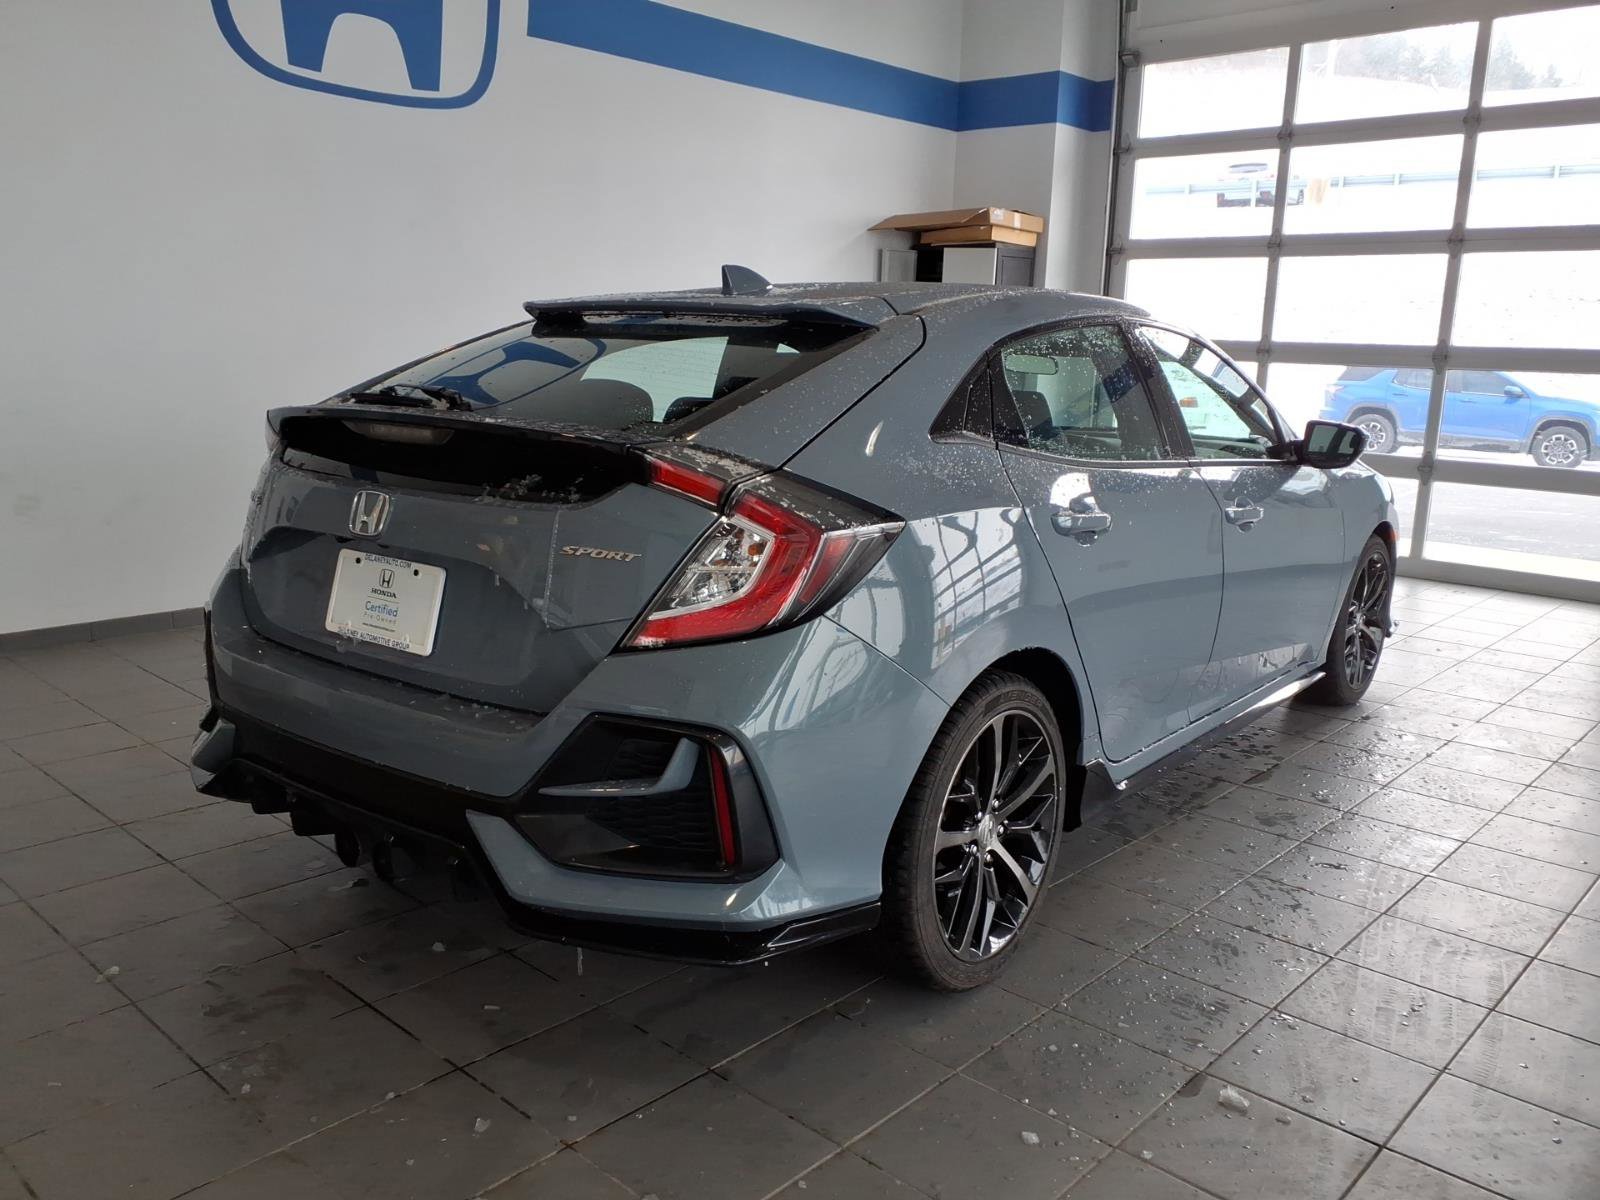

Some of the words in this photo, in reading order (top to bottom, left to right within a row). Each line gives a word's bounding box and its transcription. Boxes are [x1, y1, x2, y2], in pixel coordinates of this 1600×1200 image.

[560, 545, 642, 562] SPORT
[371, 587, 397, 599] HONDA
[365, 600, 399, 617] Certified
[360, 633, 391, 646] AUTOMOTIVE
[391, 640, 410, 650] GROUP
